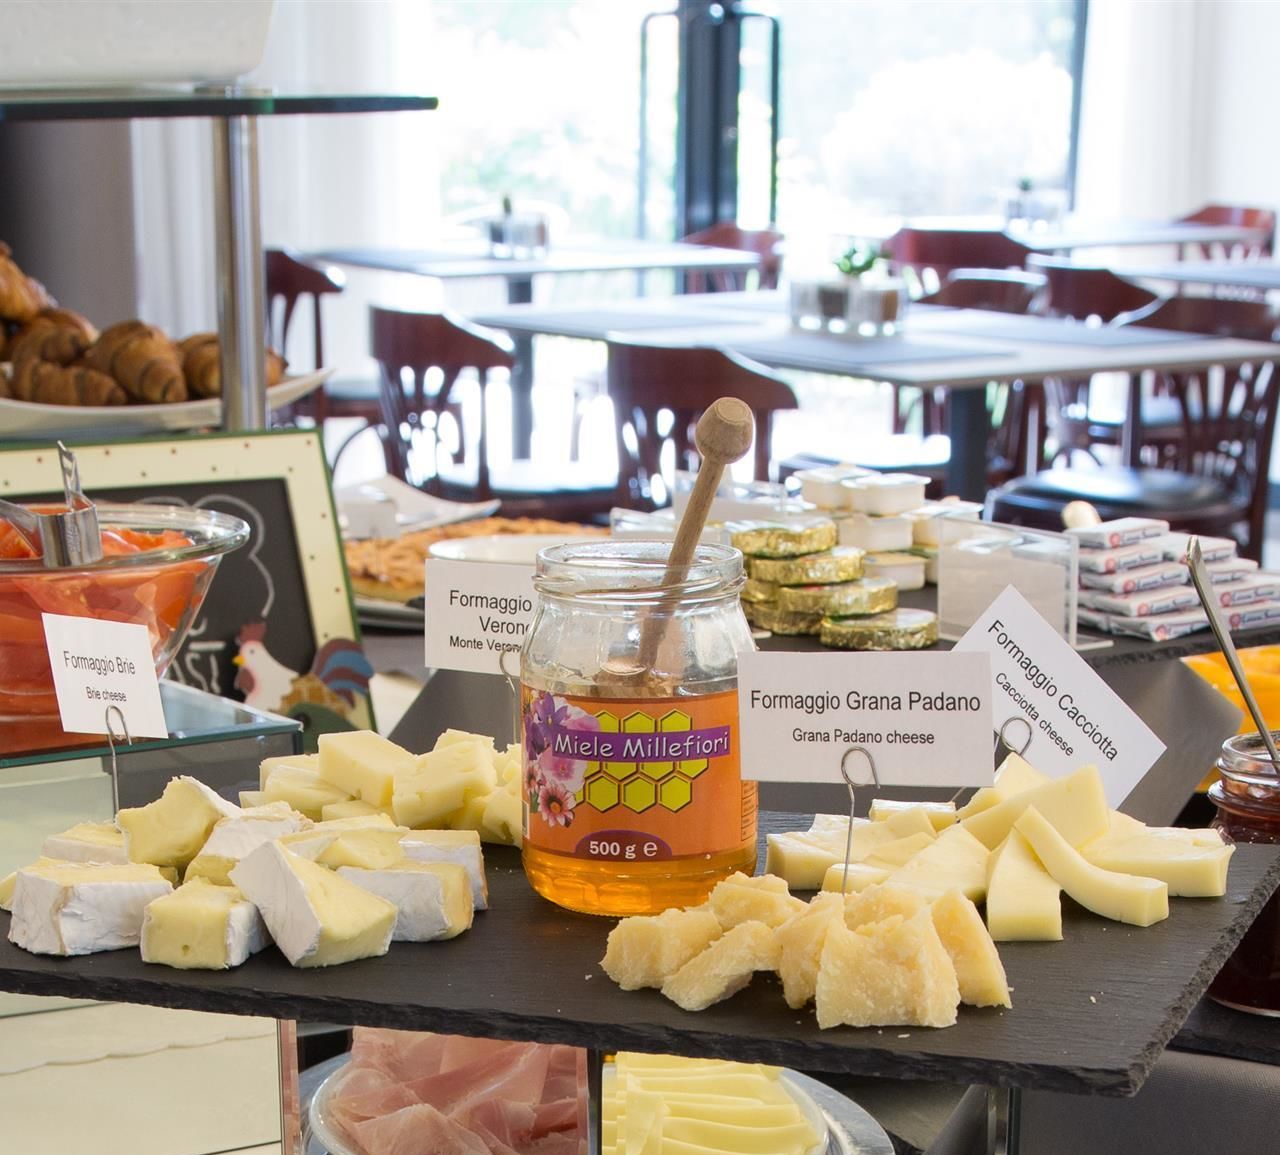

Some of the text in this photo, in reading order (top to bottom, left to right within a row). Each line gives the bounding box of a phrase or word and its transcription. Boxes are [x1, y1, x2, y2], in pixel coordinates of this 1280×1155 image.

[449, 589, 532, 615] Formaggio
[449, 635, 522, 653] Monte Veron
[63, 650, 136, 676] Formaggio Brie
[86, 686, 127, 702] Brie cheese
[750, 690, 981, 714] Formaggio Grana Padano
[987, 619, 1119, 762] Formaggio Cacciotta
[995, 672, 1074, 757] Cacciotta cheese
[554, 730, 729, 759] Miele Millefiori
[792, 727, 935, 744] Grana Padano cheese
[589, 840, 621, 856] 500
[624, 844, 637, 859] g
